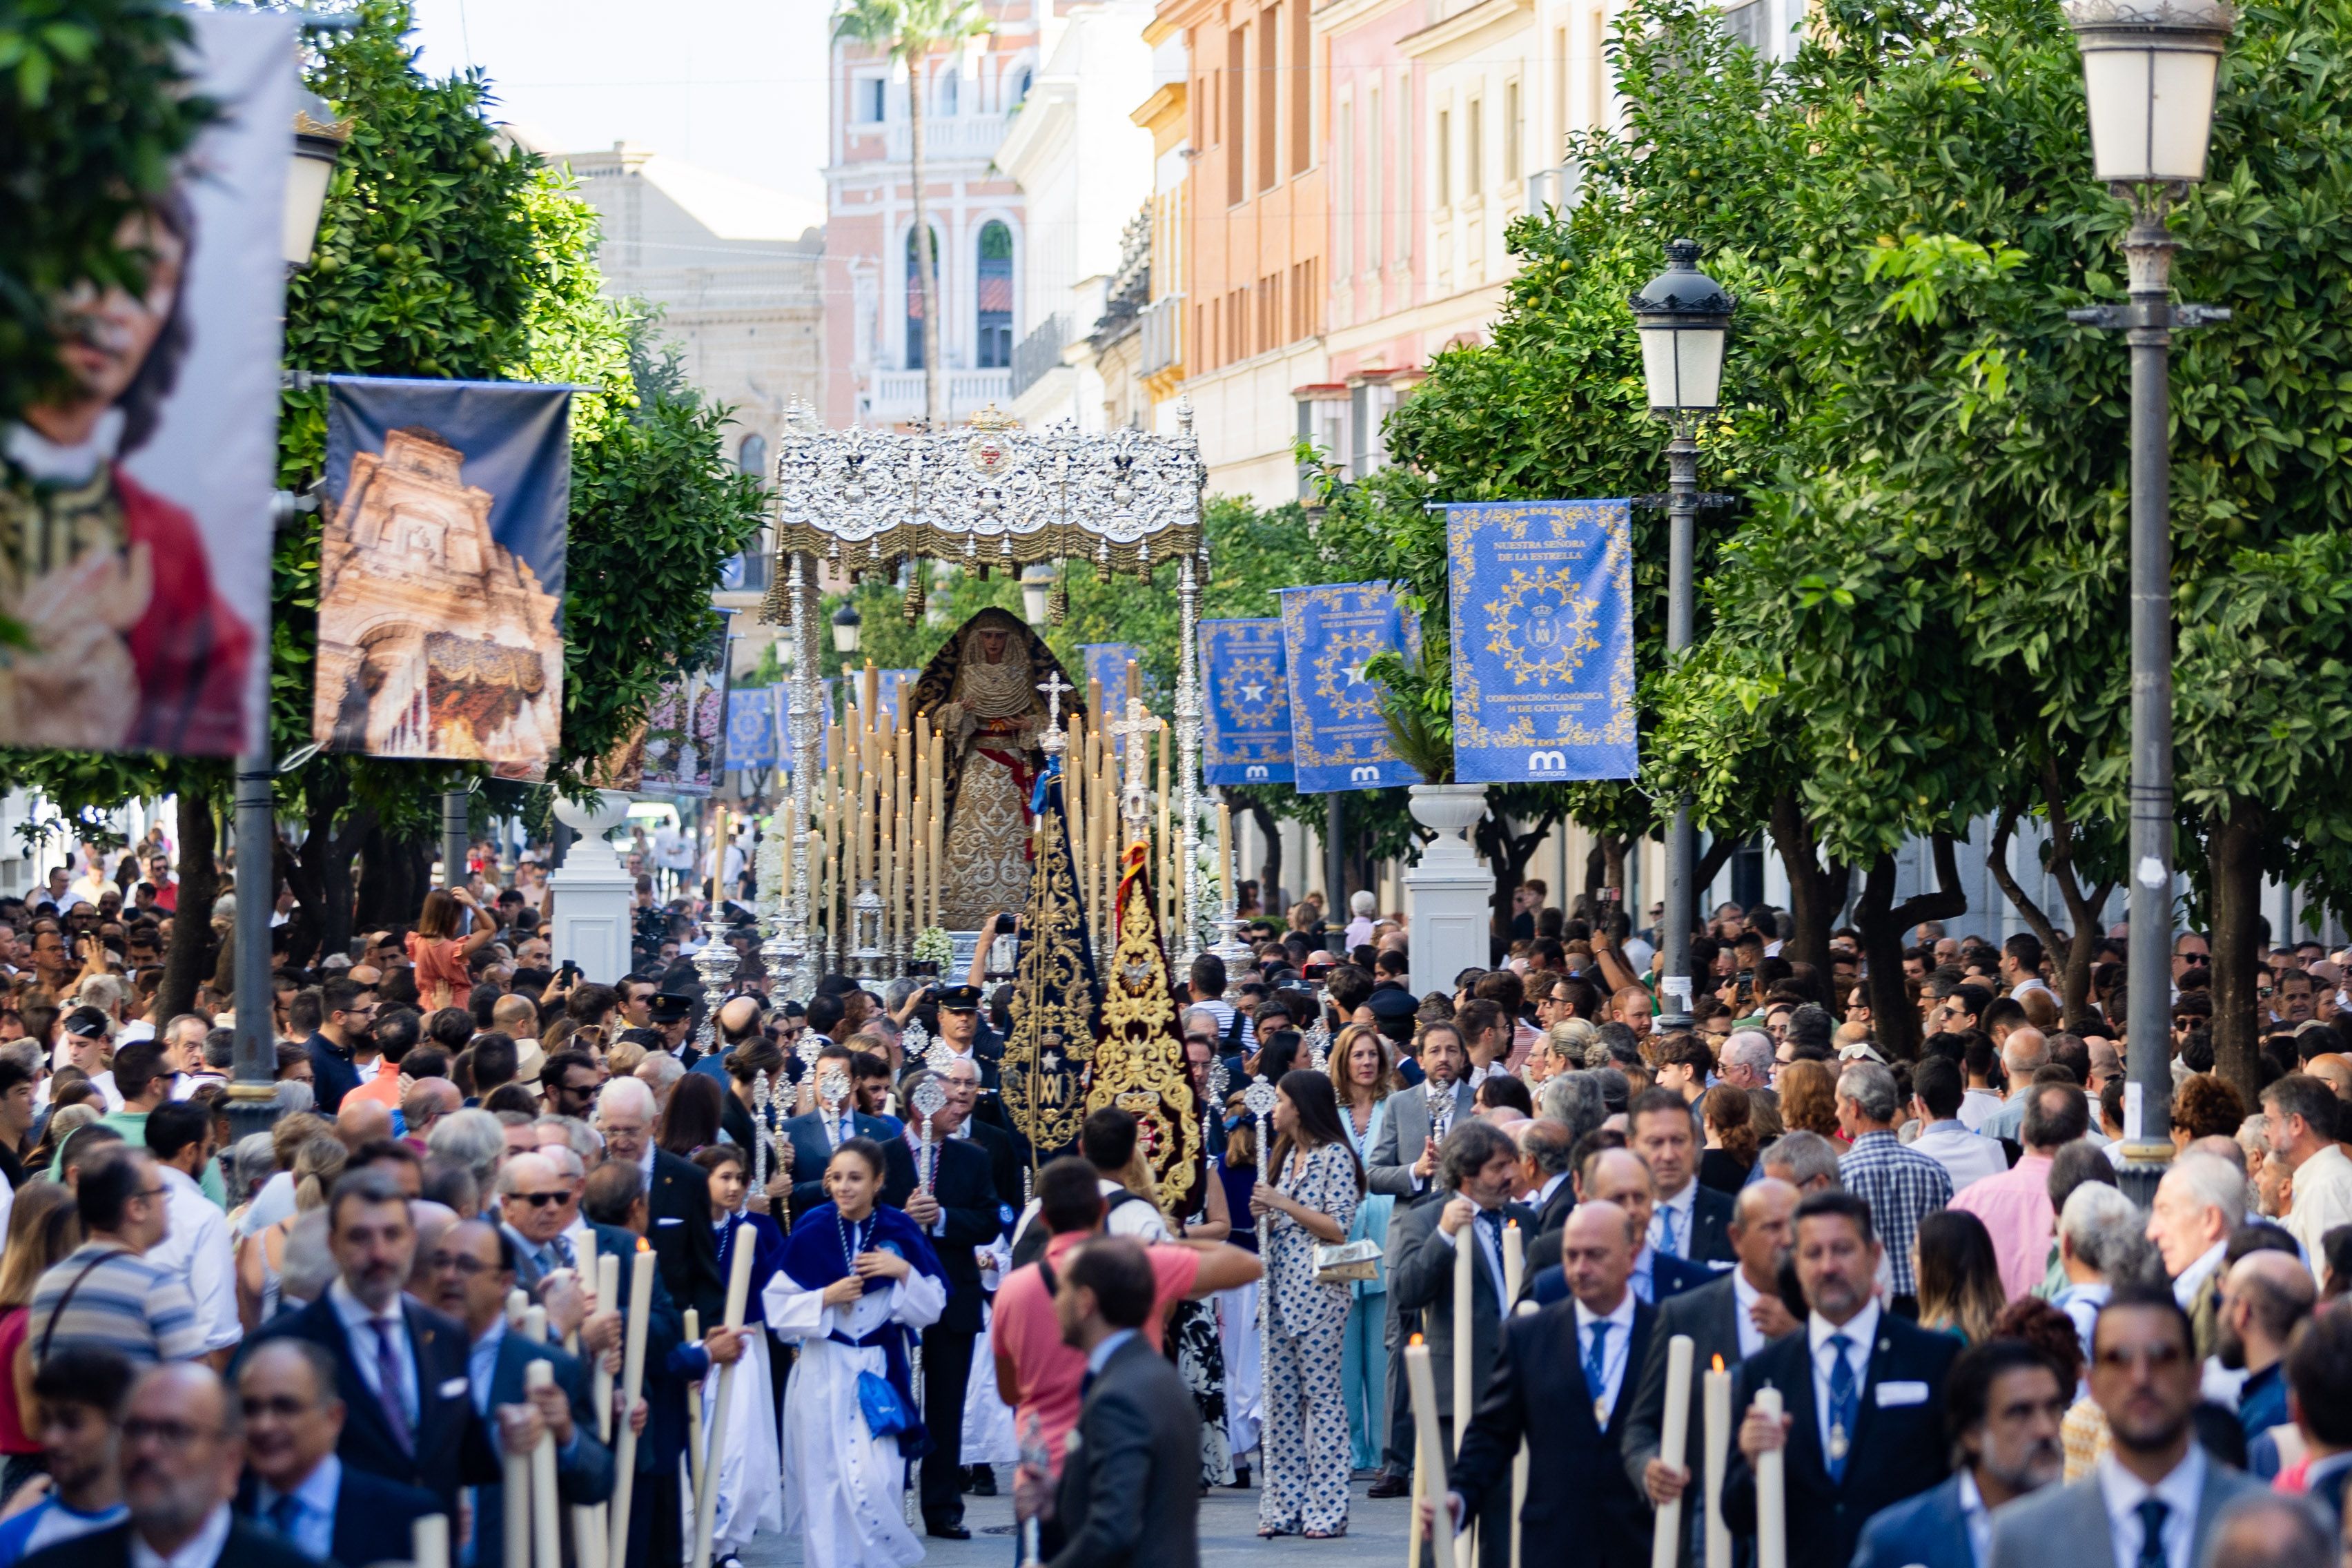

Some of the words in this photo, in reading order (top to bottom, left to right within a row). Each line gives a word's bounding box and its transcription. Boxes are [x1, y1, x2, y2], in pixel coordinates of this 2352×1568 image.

[1544, 539, 1586, 548] SEÑORA
[1486, 694, 1551, 703] CORONACIÓN
[1534, 704, 1584, 712] OCTUBRE
